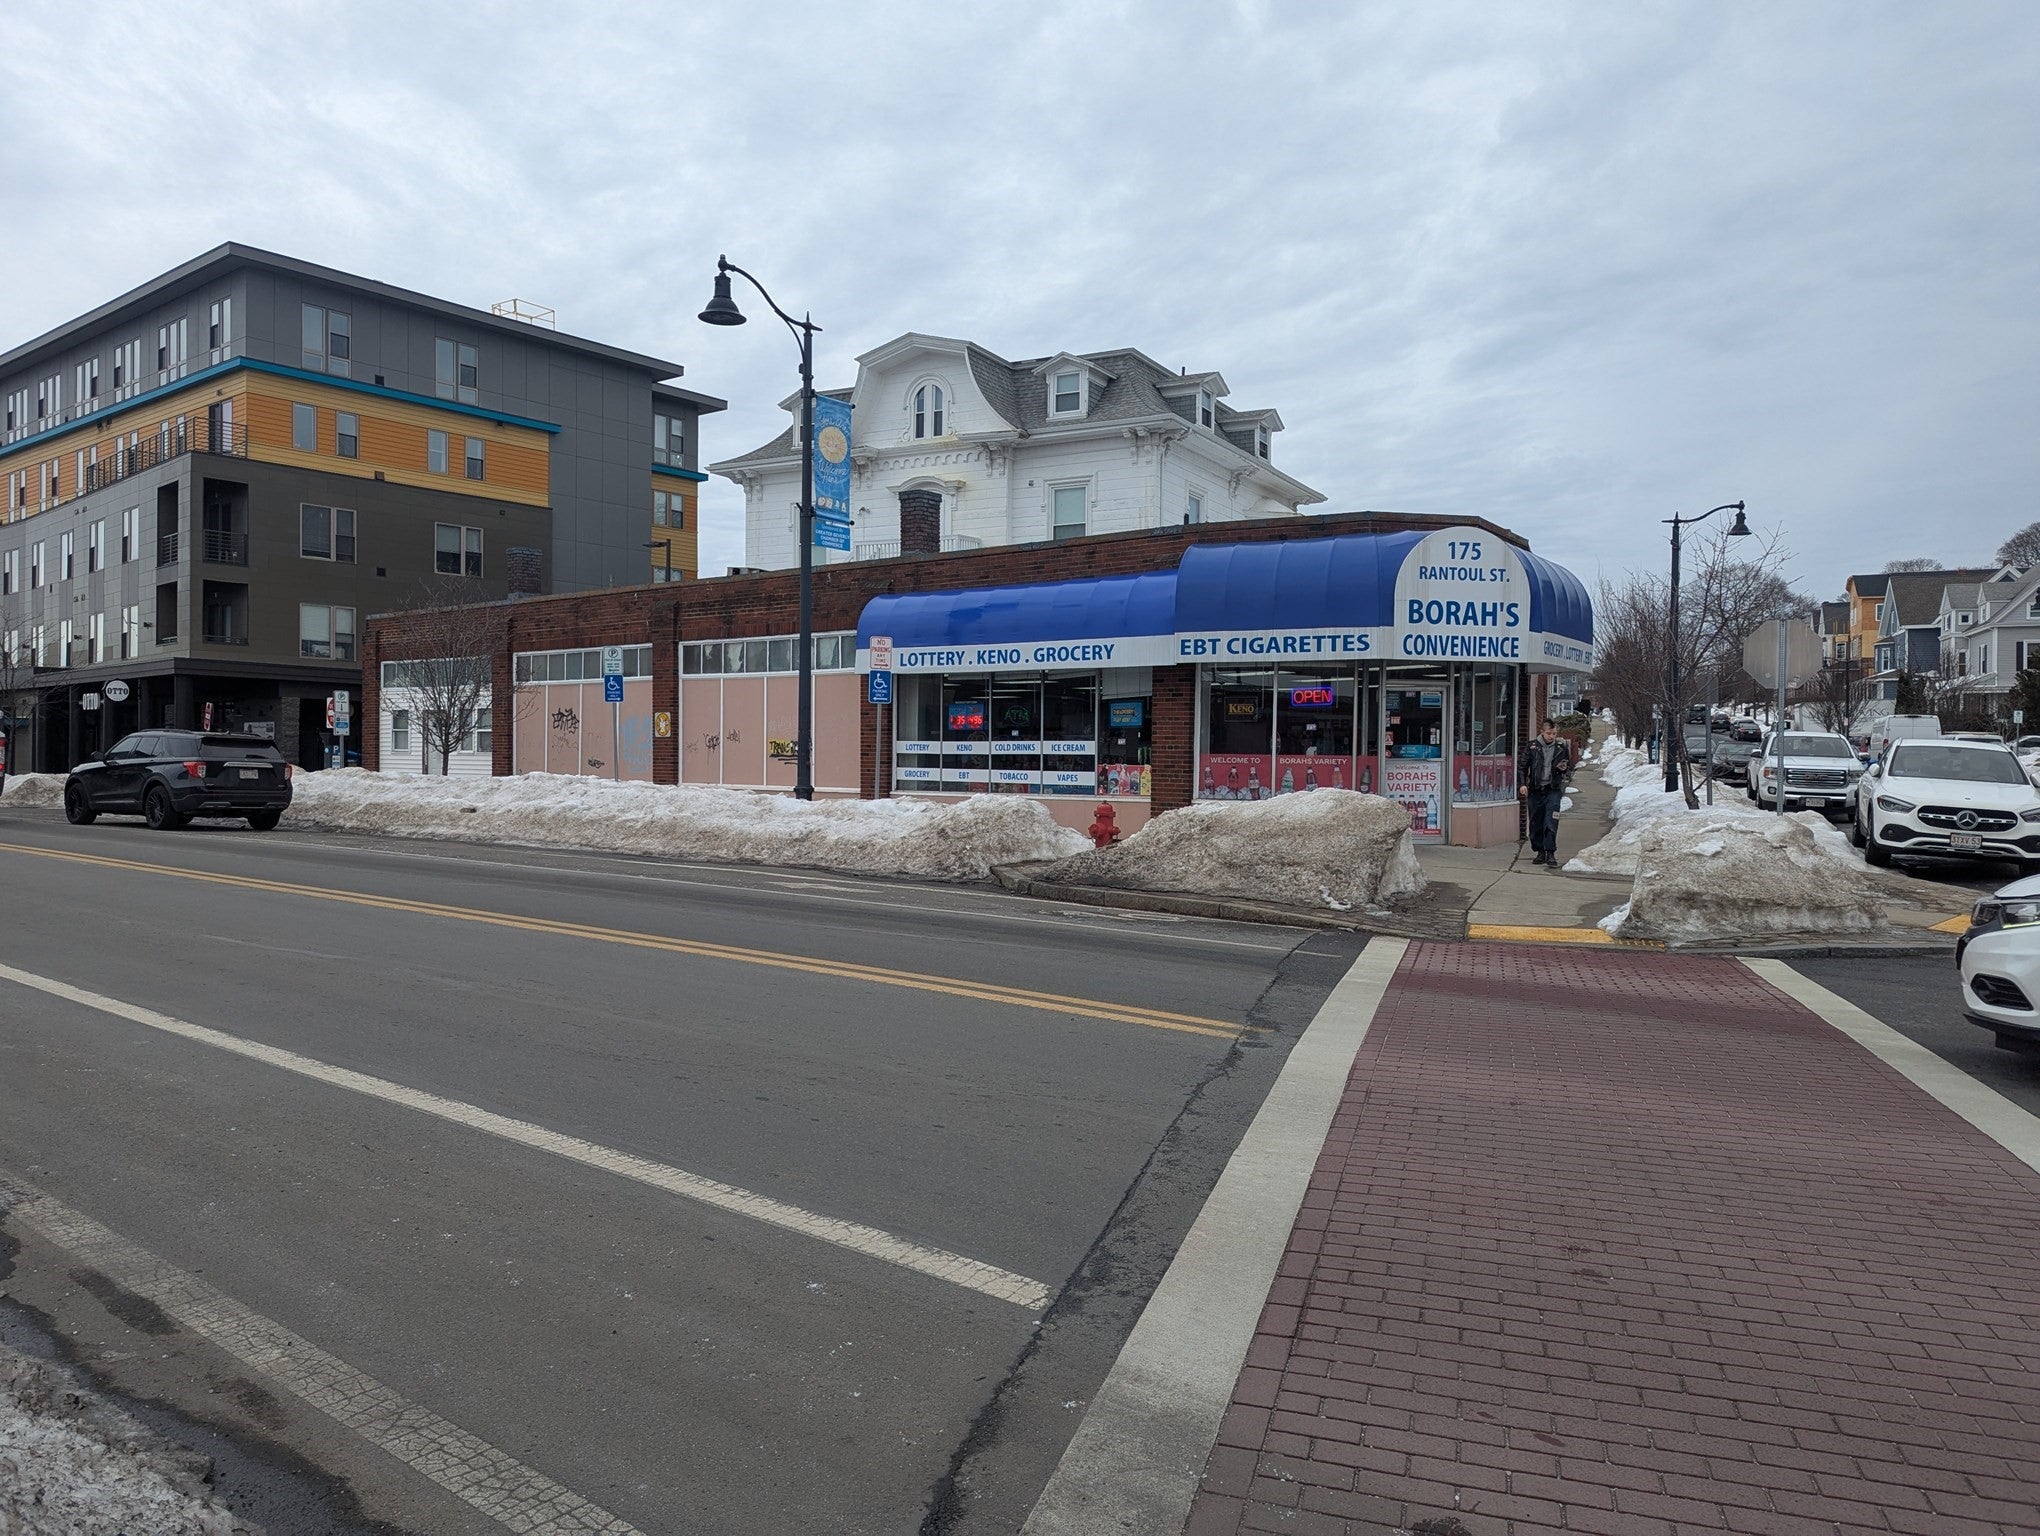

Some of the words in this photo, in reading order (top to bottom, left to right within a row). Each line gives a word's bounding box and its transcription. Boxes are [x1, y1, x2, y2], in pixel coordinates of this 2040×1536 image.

[1448, 541, 1481, 561] 175
[1419, 566, 1486, 582] RANTOUL
[1490, 568, 1510, 583] ST.
[1408, 599, 1520, 627] BORAH'S
[1180, 638, 1221, 656] EBT
[1226, 634, 1370, 655] CIGARETTES
[1402, 633, 1520, 658] CONVENIENCE
[899, 650, 965, 667] LOTTERY
[976, 649, 1021, 665] KENO
[1033, 643, 1115, 663] GROCERY
[1544, 640, 1563, 658] GROCERY
[1566, 645, 1583, 663] LOTTERY
[107, 687, 129, 695] OTTO
[1293, 690, 1331, 703] OPEN
[1228, 703, 1255, 714] KENO
[1005, 709, 1030, 721] ATM
[905, 743, 930, 752] LOTTERY
[956, 743, 973, 752] KENO
[994, 743, 1012, 752] COLD
[1012, 743, 1036, 752] DRINKS
[1051, 744, 1061, 752] ICE
[1062, 744, 1086, 752] CREAM
[904, 770, 930, 779] GROCERY
[958, 771, 970, 779] EBT
[1000, 772, 1029, 781] TOBACCO
[1057, 774, 1079, 782] VAPES
[1387, 772, 1437, 781] BORAHS
[1387, 783, 1437, 792] VARIETY
